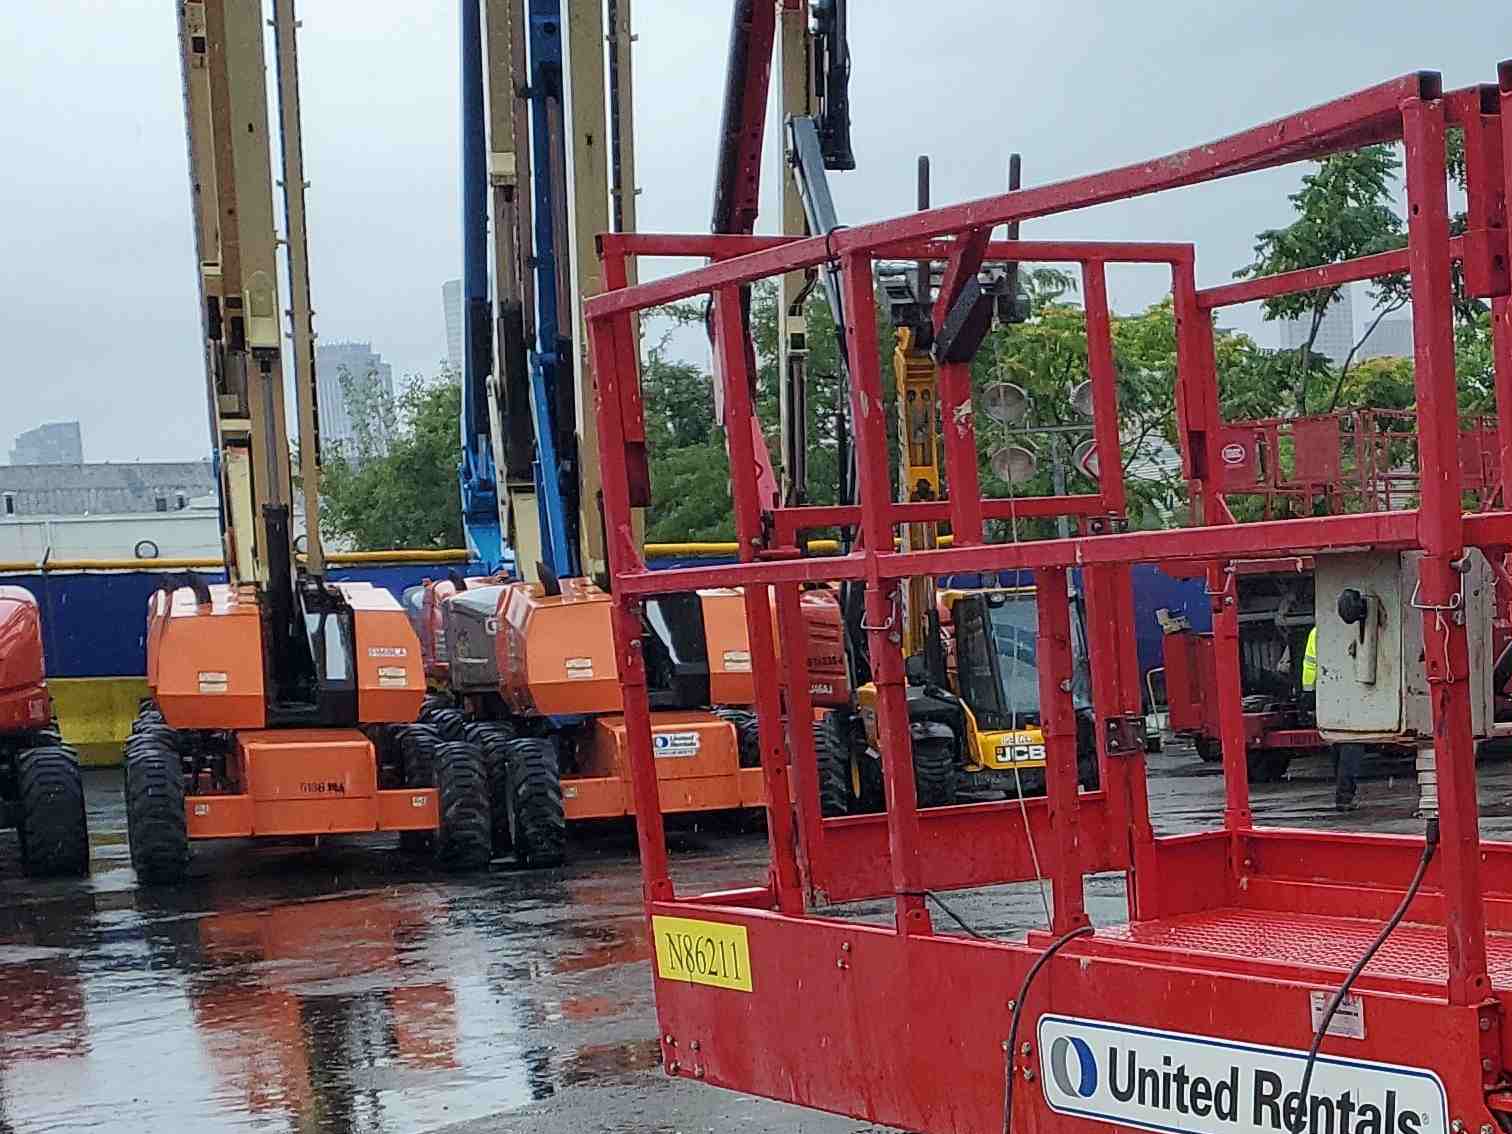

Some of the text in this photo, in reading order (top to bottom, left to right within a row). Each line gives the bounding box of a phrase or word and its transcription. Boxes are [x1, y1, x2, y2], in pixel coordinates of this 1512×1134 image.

[996, 745, 1047, 762] JCB
[665, 932, 742, 979] N86211
[1108, 1045, 1239, 1123] United
